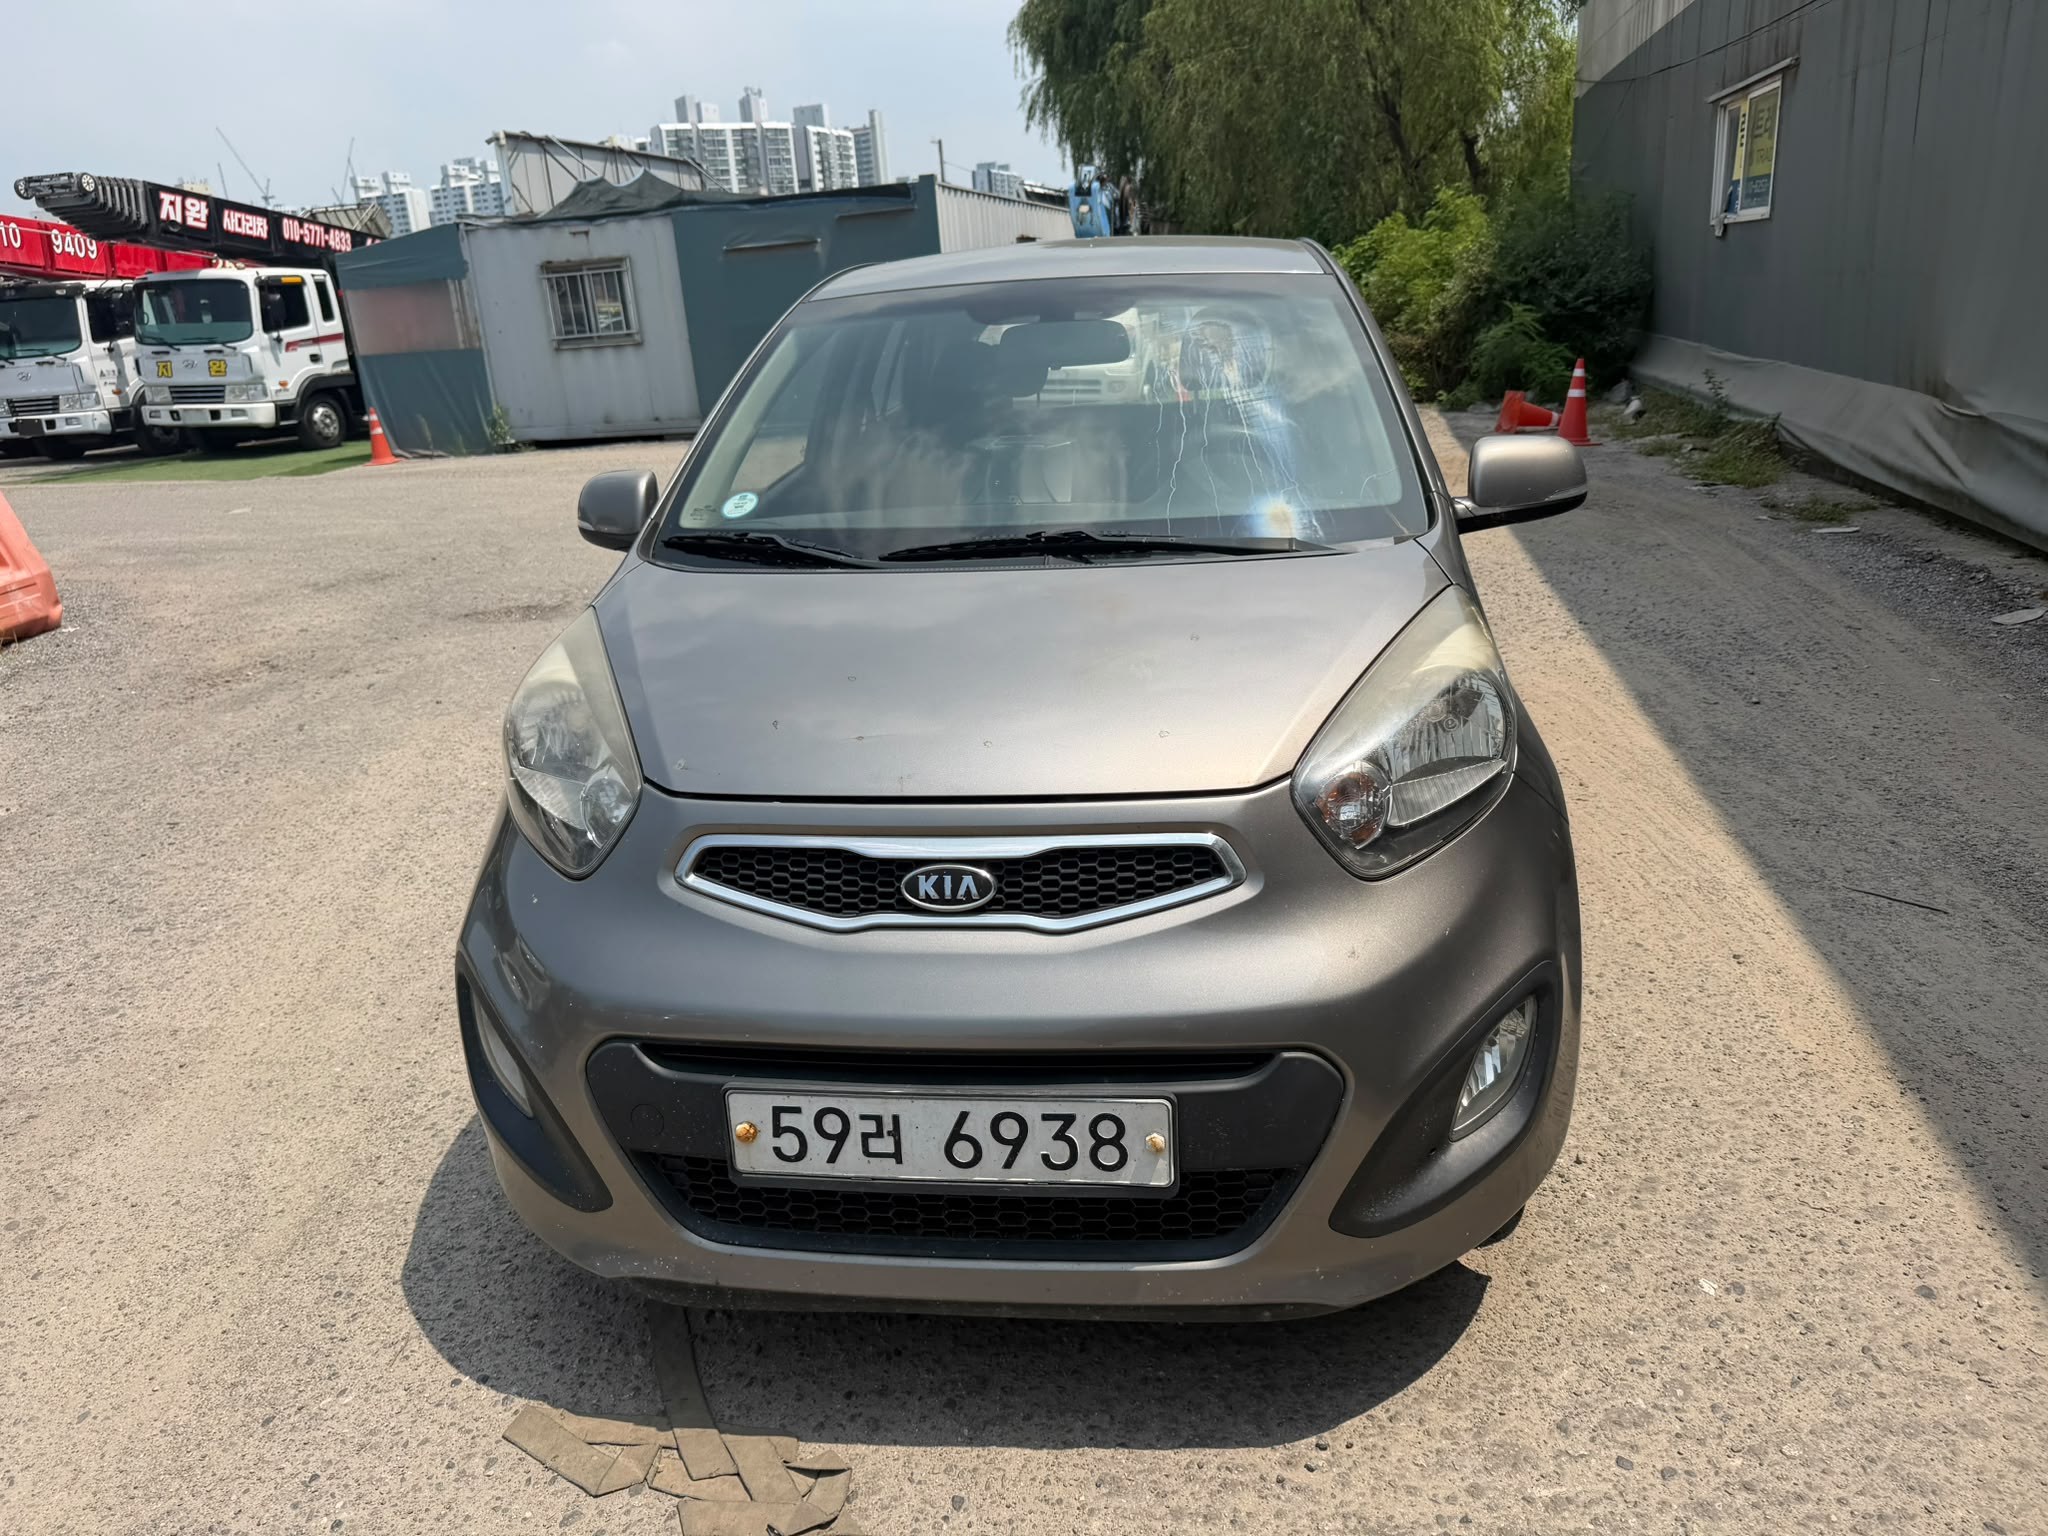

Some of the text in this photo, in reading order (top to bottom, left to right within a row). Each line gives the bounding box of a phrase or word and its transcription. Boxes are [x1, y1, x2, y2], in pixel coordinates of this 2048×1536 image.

[160, 191, 352, 252] 지완 사다리차 010-5771-4833
[51, 229, 98, 259] 9409
[156, 359, 227, 378] 지 완
[917, 874, 980, 900] KIA
[771, 1105, 1129, 1173] 59러 6938
